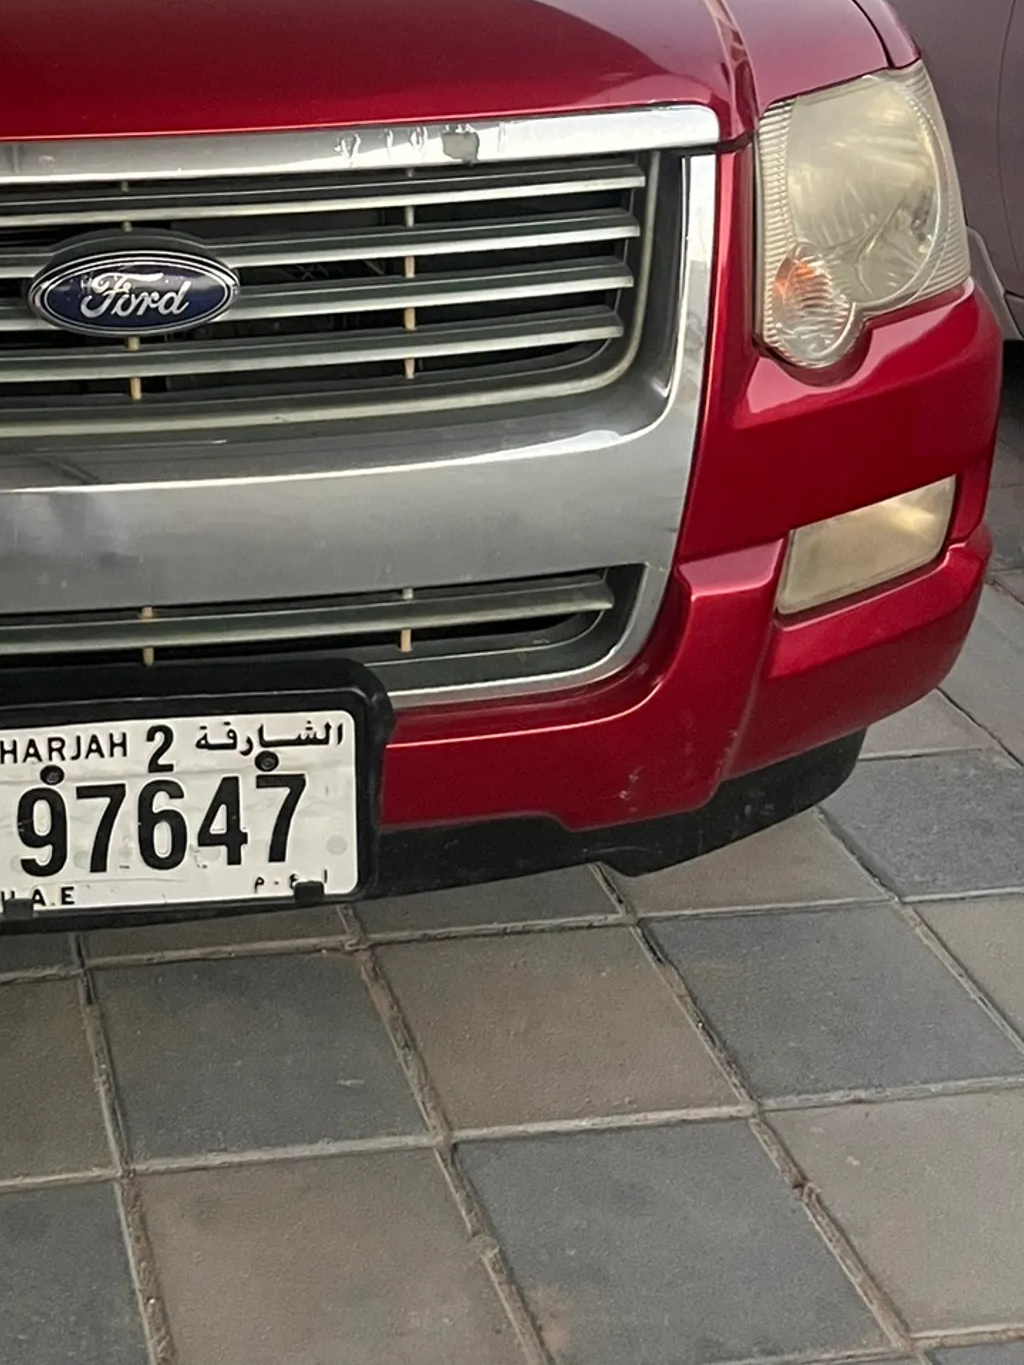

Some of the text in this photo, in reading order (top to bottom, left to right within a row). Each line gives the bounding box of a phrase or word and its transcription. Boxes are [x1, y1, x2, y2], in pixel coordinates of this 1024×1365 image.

[80, 272, 192, 318] Ford
[145, 724, 175, 773] 2
[195, 720, 343, 756] الشارقة
[17, 773, 306, 877] 97647
